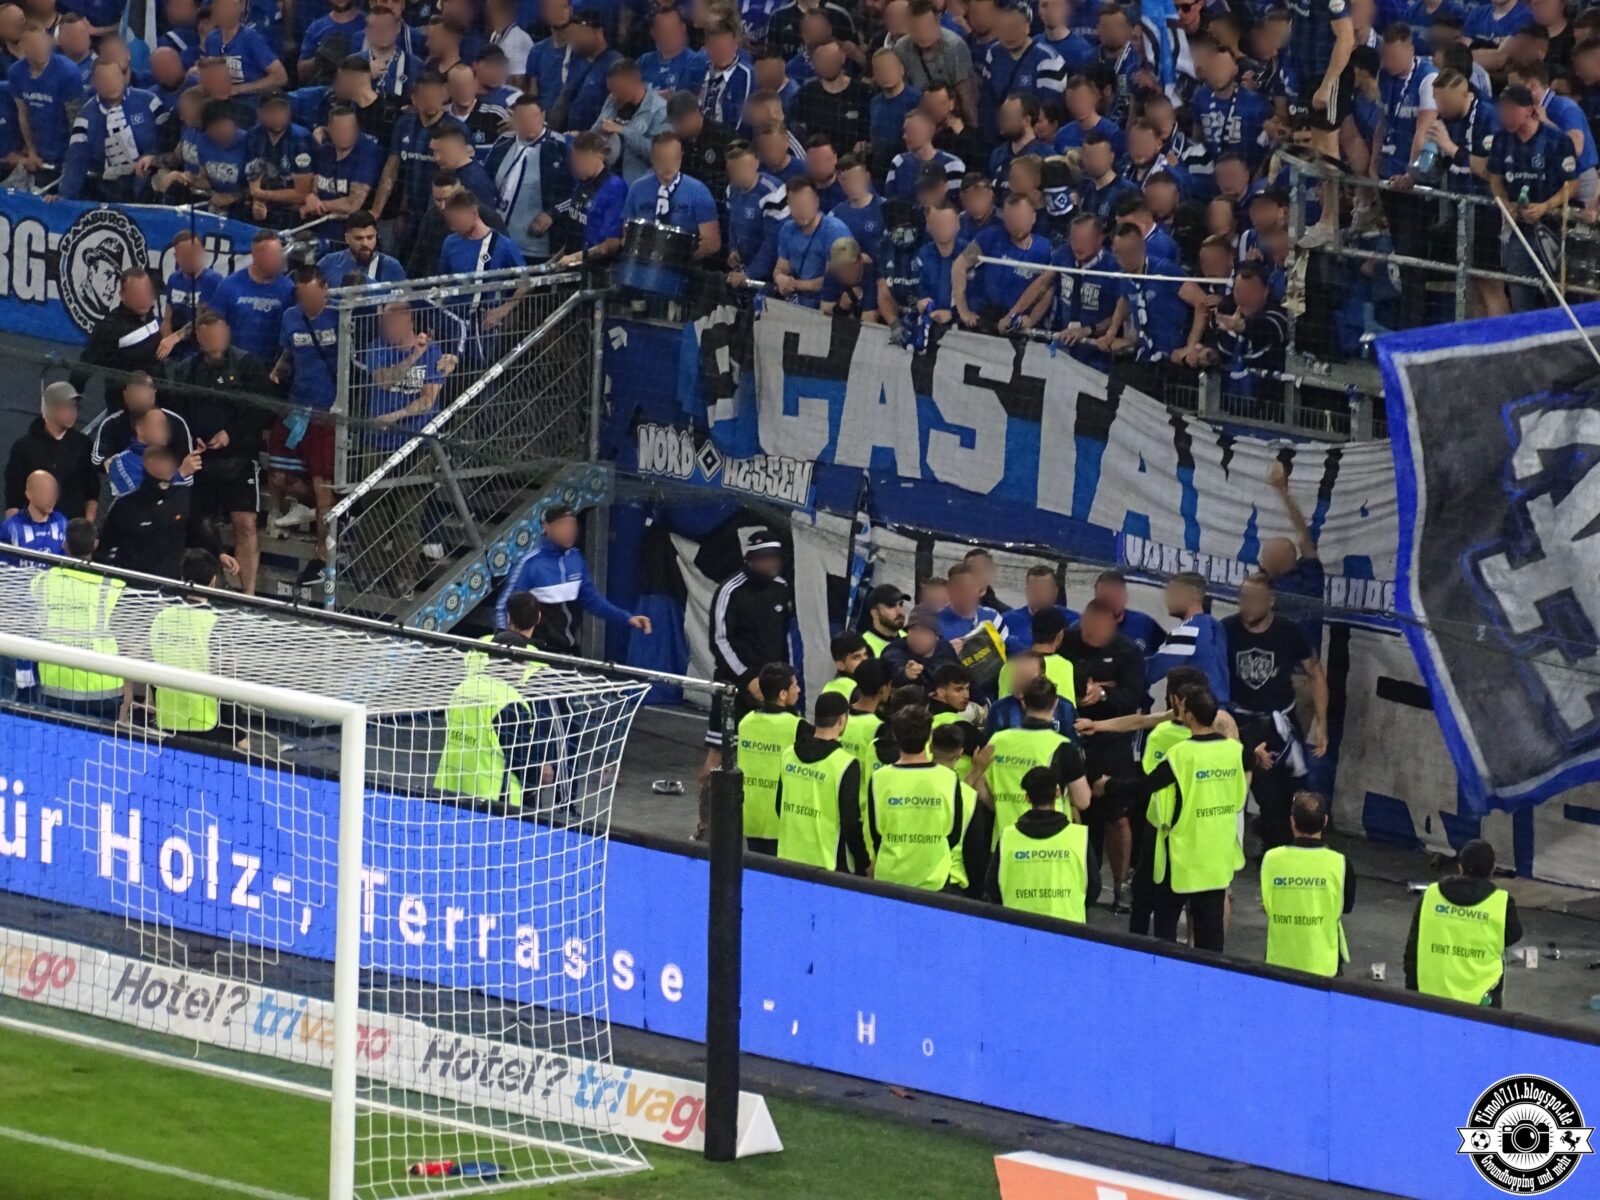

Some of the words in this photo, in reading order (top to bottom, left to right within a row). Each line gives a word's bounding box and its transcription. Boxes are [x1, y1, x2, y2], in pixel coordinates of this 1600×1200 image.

[752, 297, 1398, 582] CASTAWA
[638, 424, 696, 478] NORD
[722, 455, 814, 506] HESSEN
[904, 796, 942, 806] POWER
[908, 833, 943, 845] SECURITY
[1030, 849, 1071, 860] POWER
[1288, 876, 1327, 887] POWER
[1015, 889, 1038, 900] EVENT
[1039, 888, 1072, 900] SECURITY
[1450, 905, 1490, 921] POWER
[1294, 915, 1324, 926] SECURITY
[1451, 945, 1487, 960] SECURITY
[111, 962, 250, 1028] Hotel?
[419, 1033, 569, 1100] Hotel?
[574, 1065, 705, 1143] trivag
